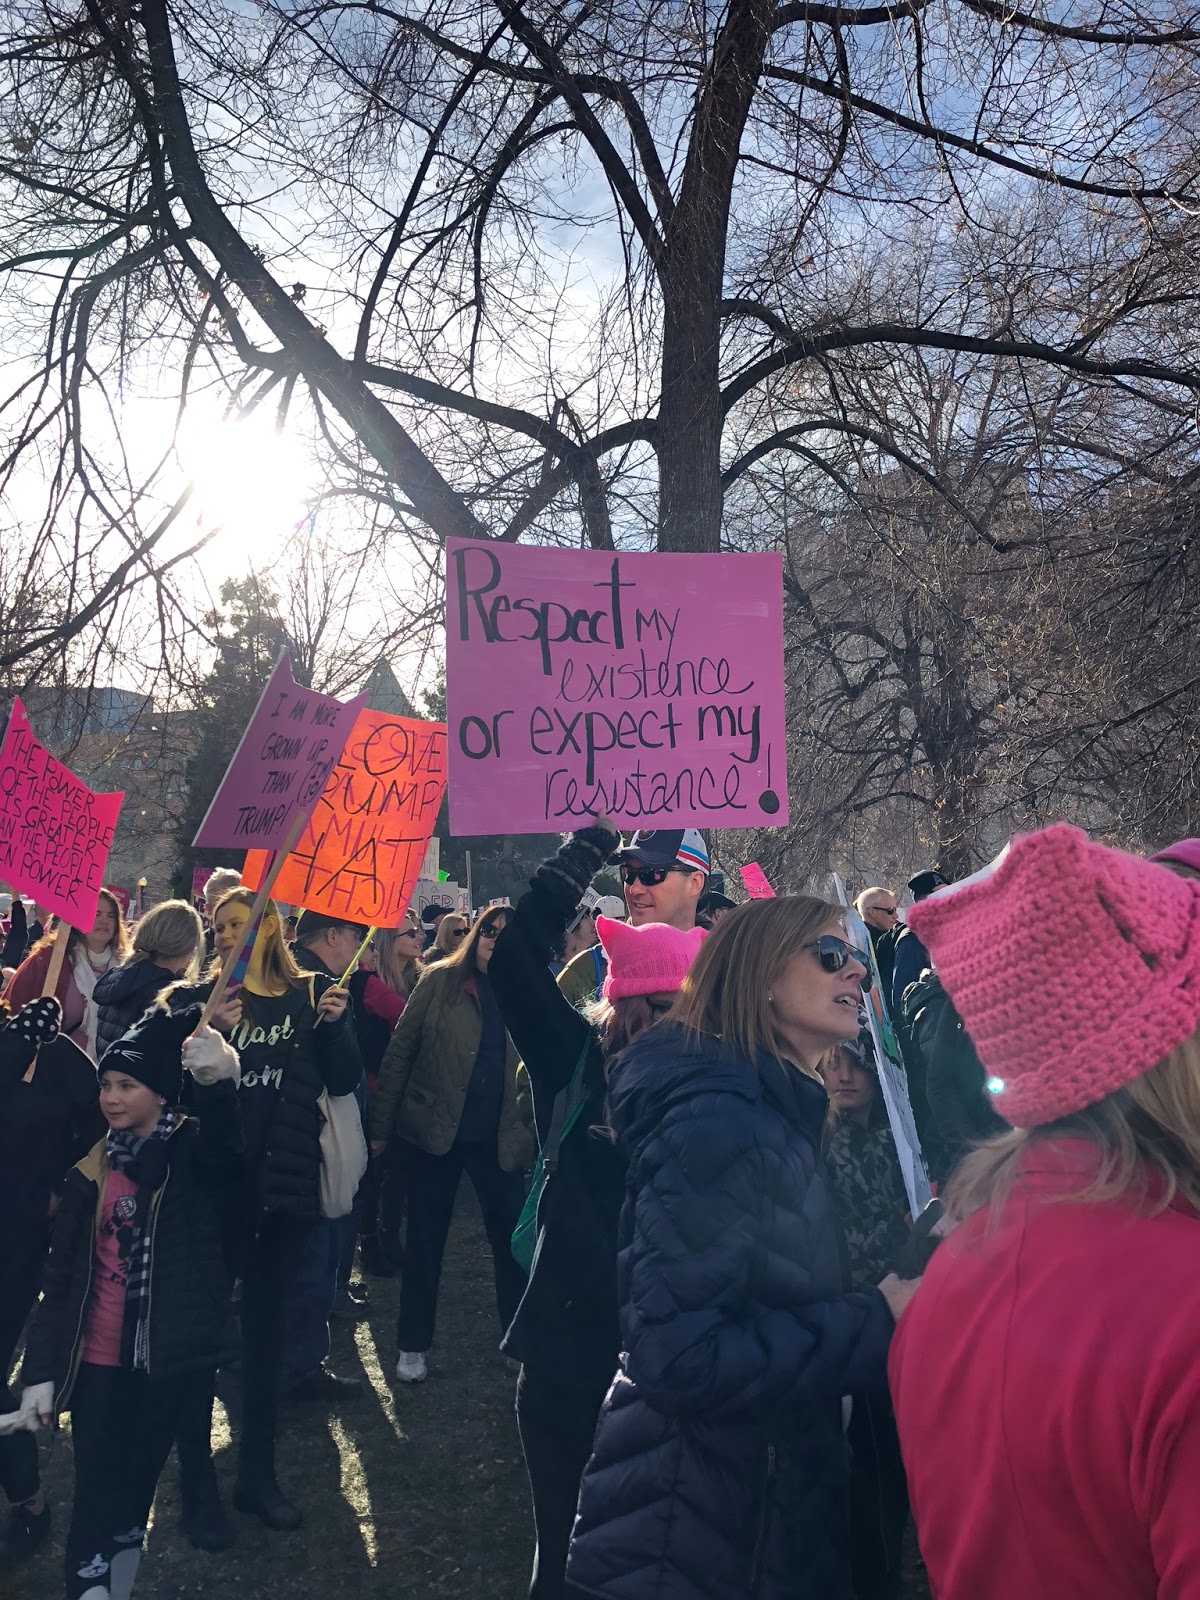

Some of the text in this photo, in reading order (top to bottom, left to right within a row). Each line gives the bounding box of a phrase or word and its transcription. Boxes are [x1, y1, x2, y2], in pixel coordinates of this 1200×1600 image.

[452, 546, 636, 676] Respect
[556, 649, 754, 702] existence
[271, 692, 341, 728] I AM MORE
[261, 732, 328, 763] GROWN UP
[459, 702, 760, 786] or expect my
[12, 729, 95, 817] THE POWER
[262, 770, 298, 794] THAN
[1, 766, 115, 849] OF THE PEOPLE
[1, 792, 97, 860] IS GREATER
[234, 800, 294, 835] TRUMP!
[0, 817, 99, 892] AN THE PEOPLE
[20, 852, 80, 909] POWER
[235, 1064, 283, 1091] om
